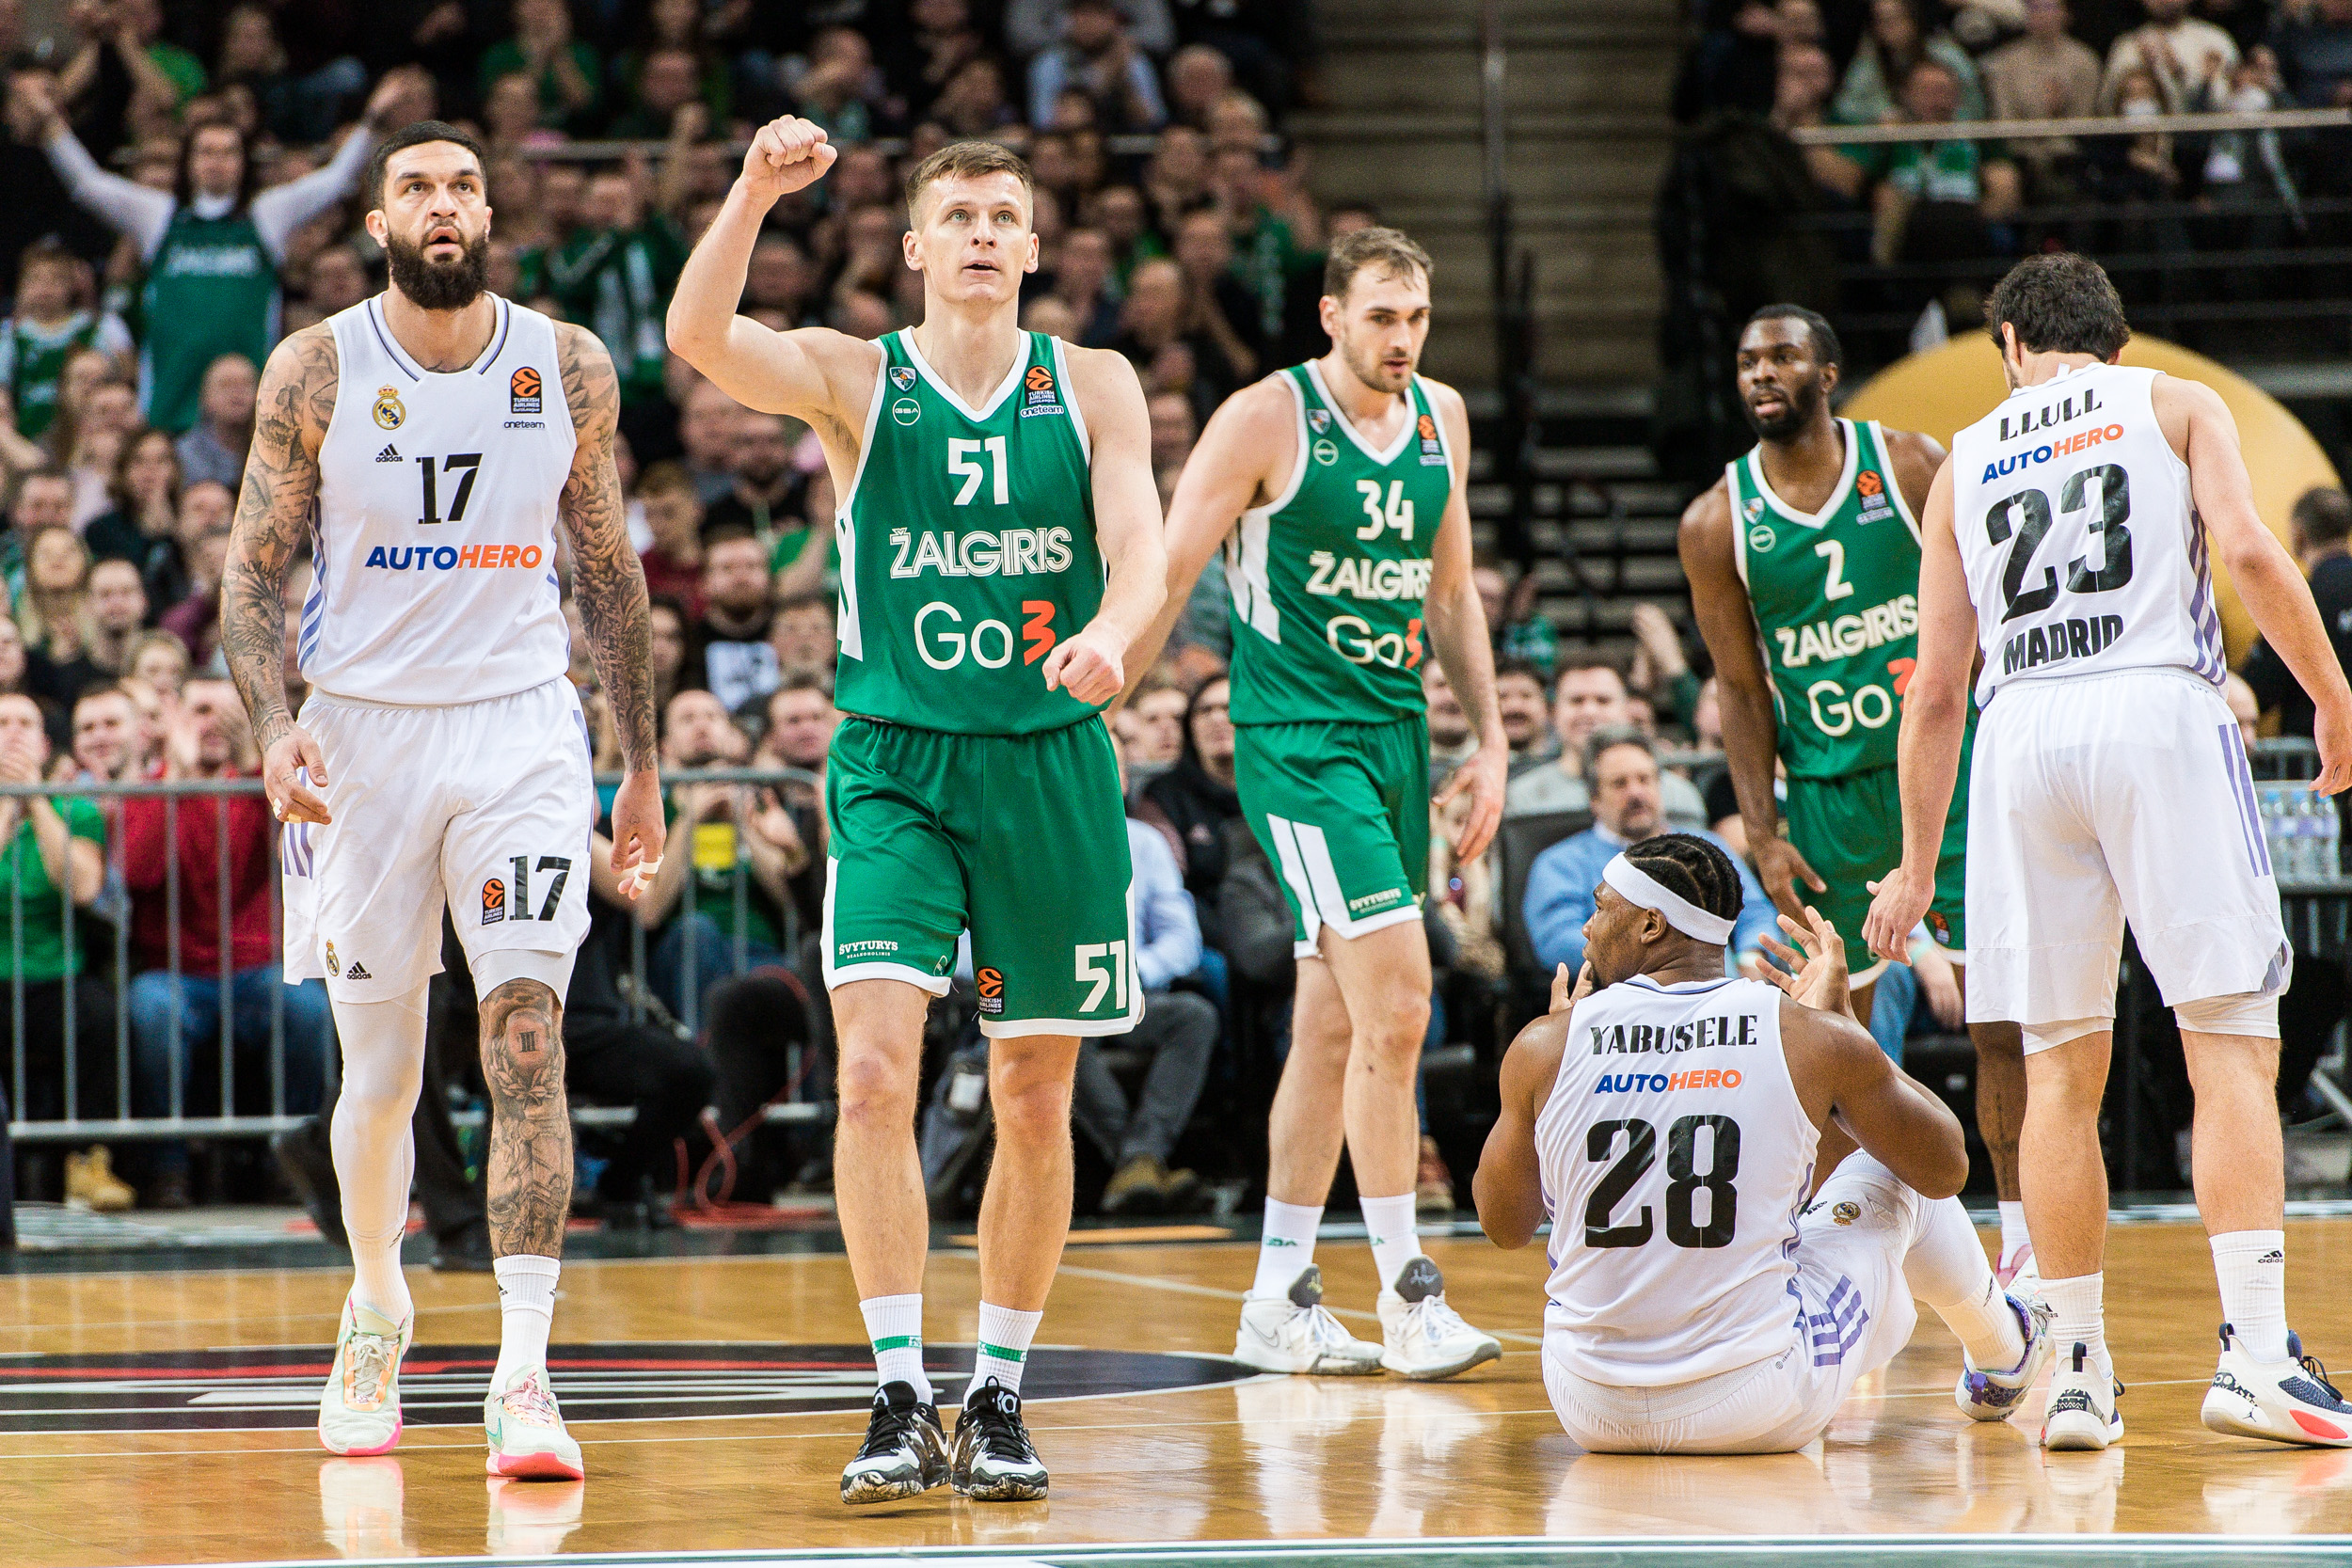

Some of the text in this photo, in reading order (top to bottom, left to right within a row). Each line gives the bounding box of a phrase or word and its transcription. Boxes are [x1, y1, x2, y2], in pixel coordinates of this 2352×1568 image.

[503, 420, 546, 429] oneteam
[1021, 404, 1064, 417] oneteam
[1999, 388, 2103, 442] LLULL
[375, 454, 404, 463] adidas
[947, 436, 1009, 505] 51
[1981, 423, 2124, 485] AUTOHERO
[415, 452, 484, 525] 17
[1356, 480, 1414, 541] 34
[365, 544, 543, 571] AUTOHERO
[889, 526, 1073, 579] ŽALGIRIS
[1814, 539, 1854, 601] 2
[1985, 463, 2134, 626] 23
[914, 599, 1057, 672] Go3
[1774, 594, 1919, 669] ŽALGIRIS
[2003, 613, 2124, 676] MADRID
[509, 855, 573, 922] 17
[838, 940, 898, 956] ŠVYTURYS
[1074, 939, 1128, 1013] 51
[1590, 1015, 1757, 1054] YABUSELE
[1594, 1069, 1742, 1094] AUTOHERO
[1584, 1114, 1741, 1249] 28
